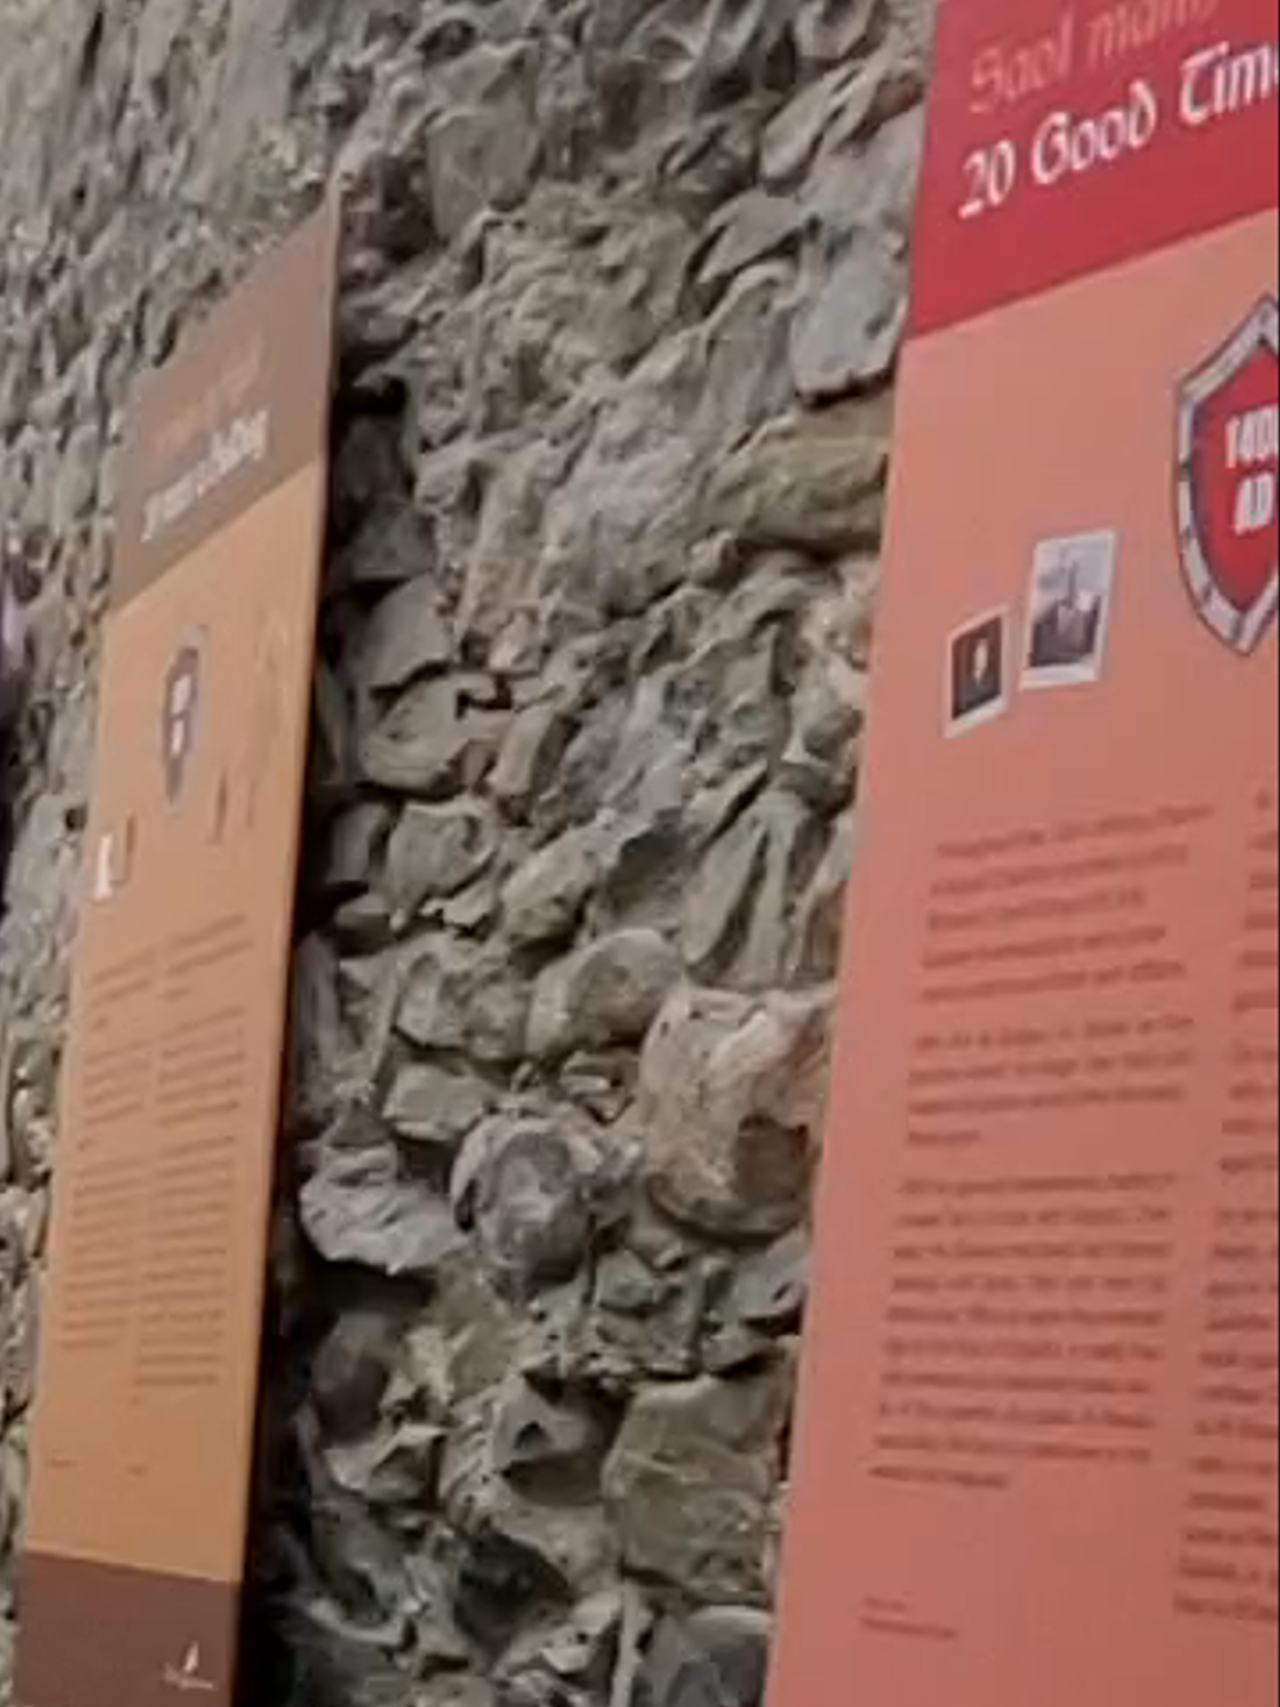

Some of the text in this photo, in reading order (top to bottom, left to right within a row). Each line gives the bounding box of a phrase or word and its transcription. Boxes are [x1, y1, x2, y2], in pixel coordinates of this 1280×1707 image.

[958, 40, 1279, 220] 20 Good Tim
[969, 4, 1074, 114] Saol
